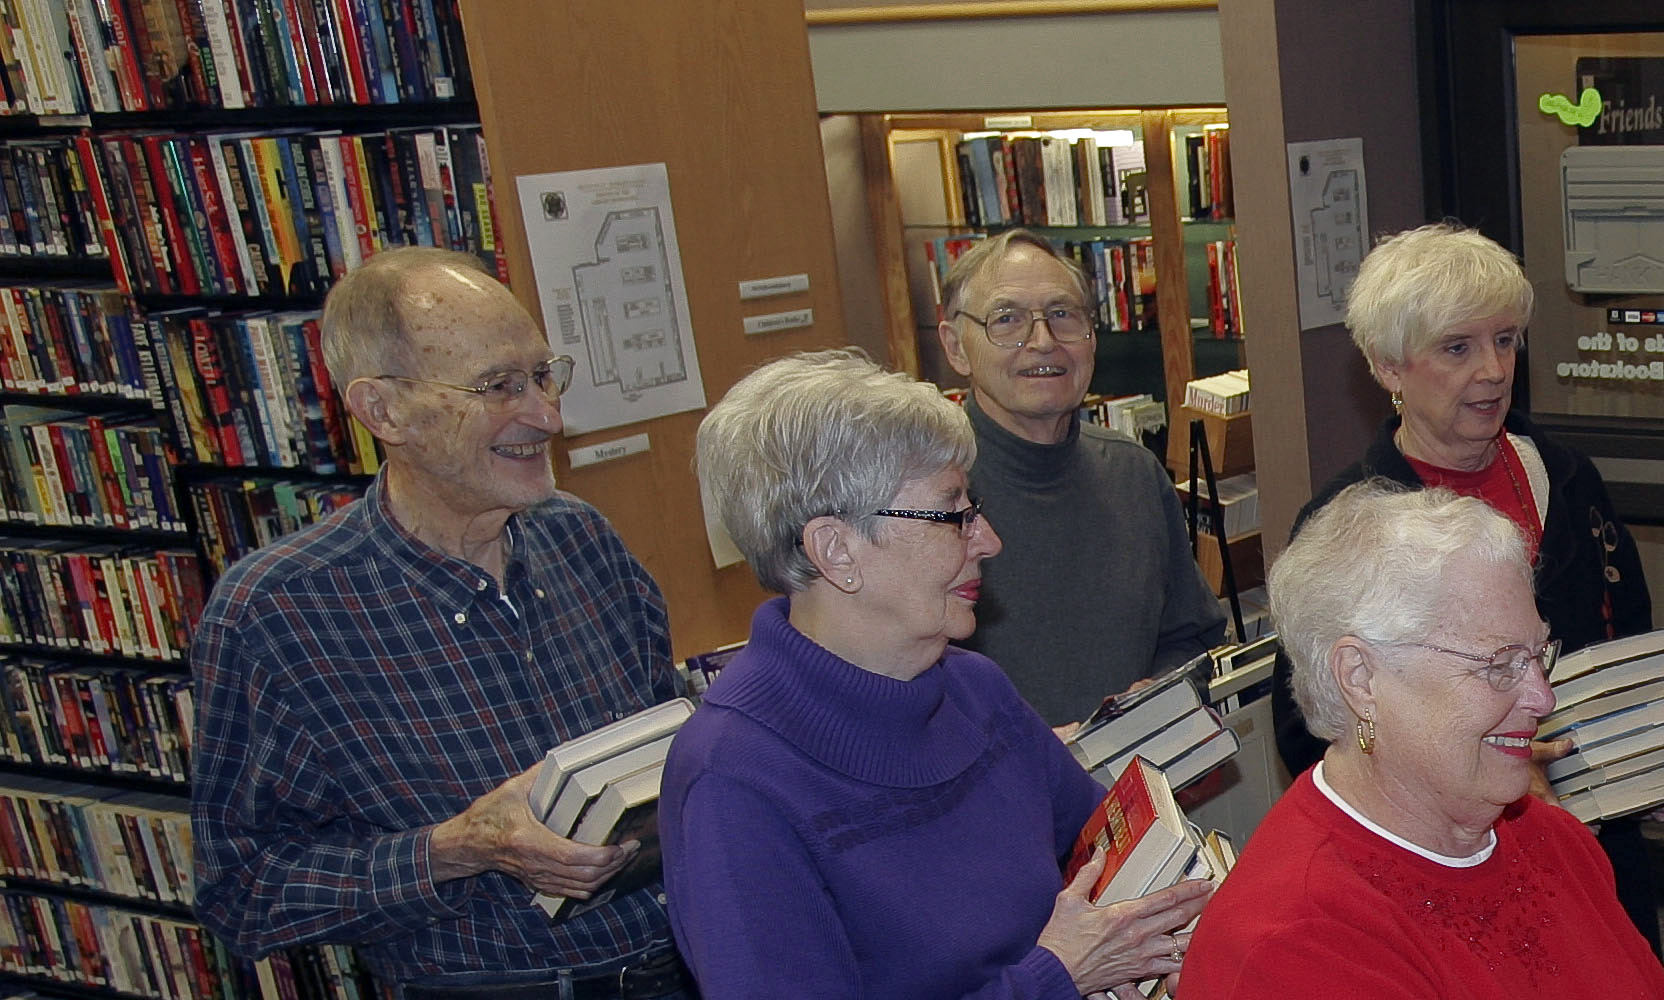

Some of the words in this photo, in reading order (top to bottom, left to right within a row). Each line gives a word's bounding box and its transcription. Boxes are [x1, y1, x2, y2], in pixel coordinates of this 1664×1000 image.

[1598, 96, 1663, 135] Friends
[1188, 389, 1224, 414] Murder
[594, 446, 626, 461] Mystery
